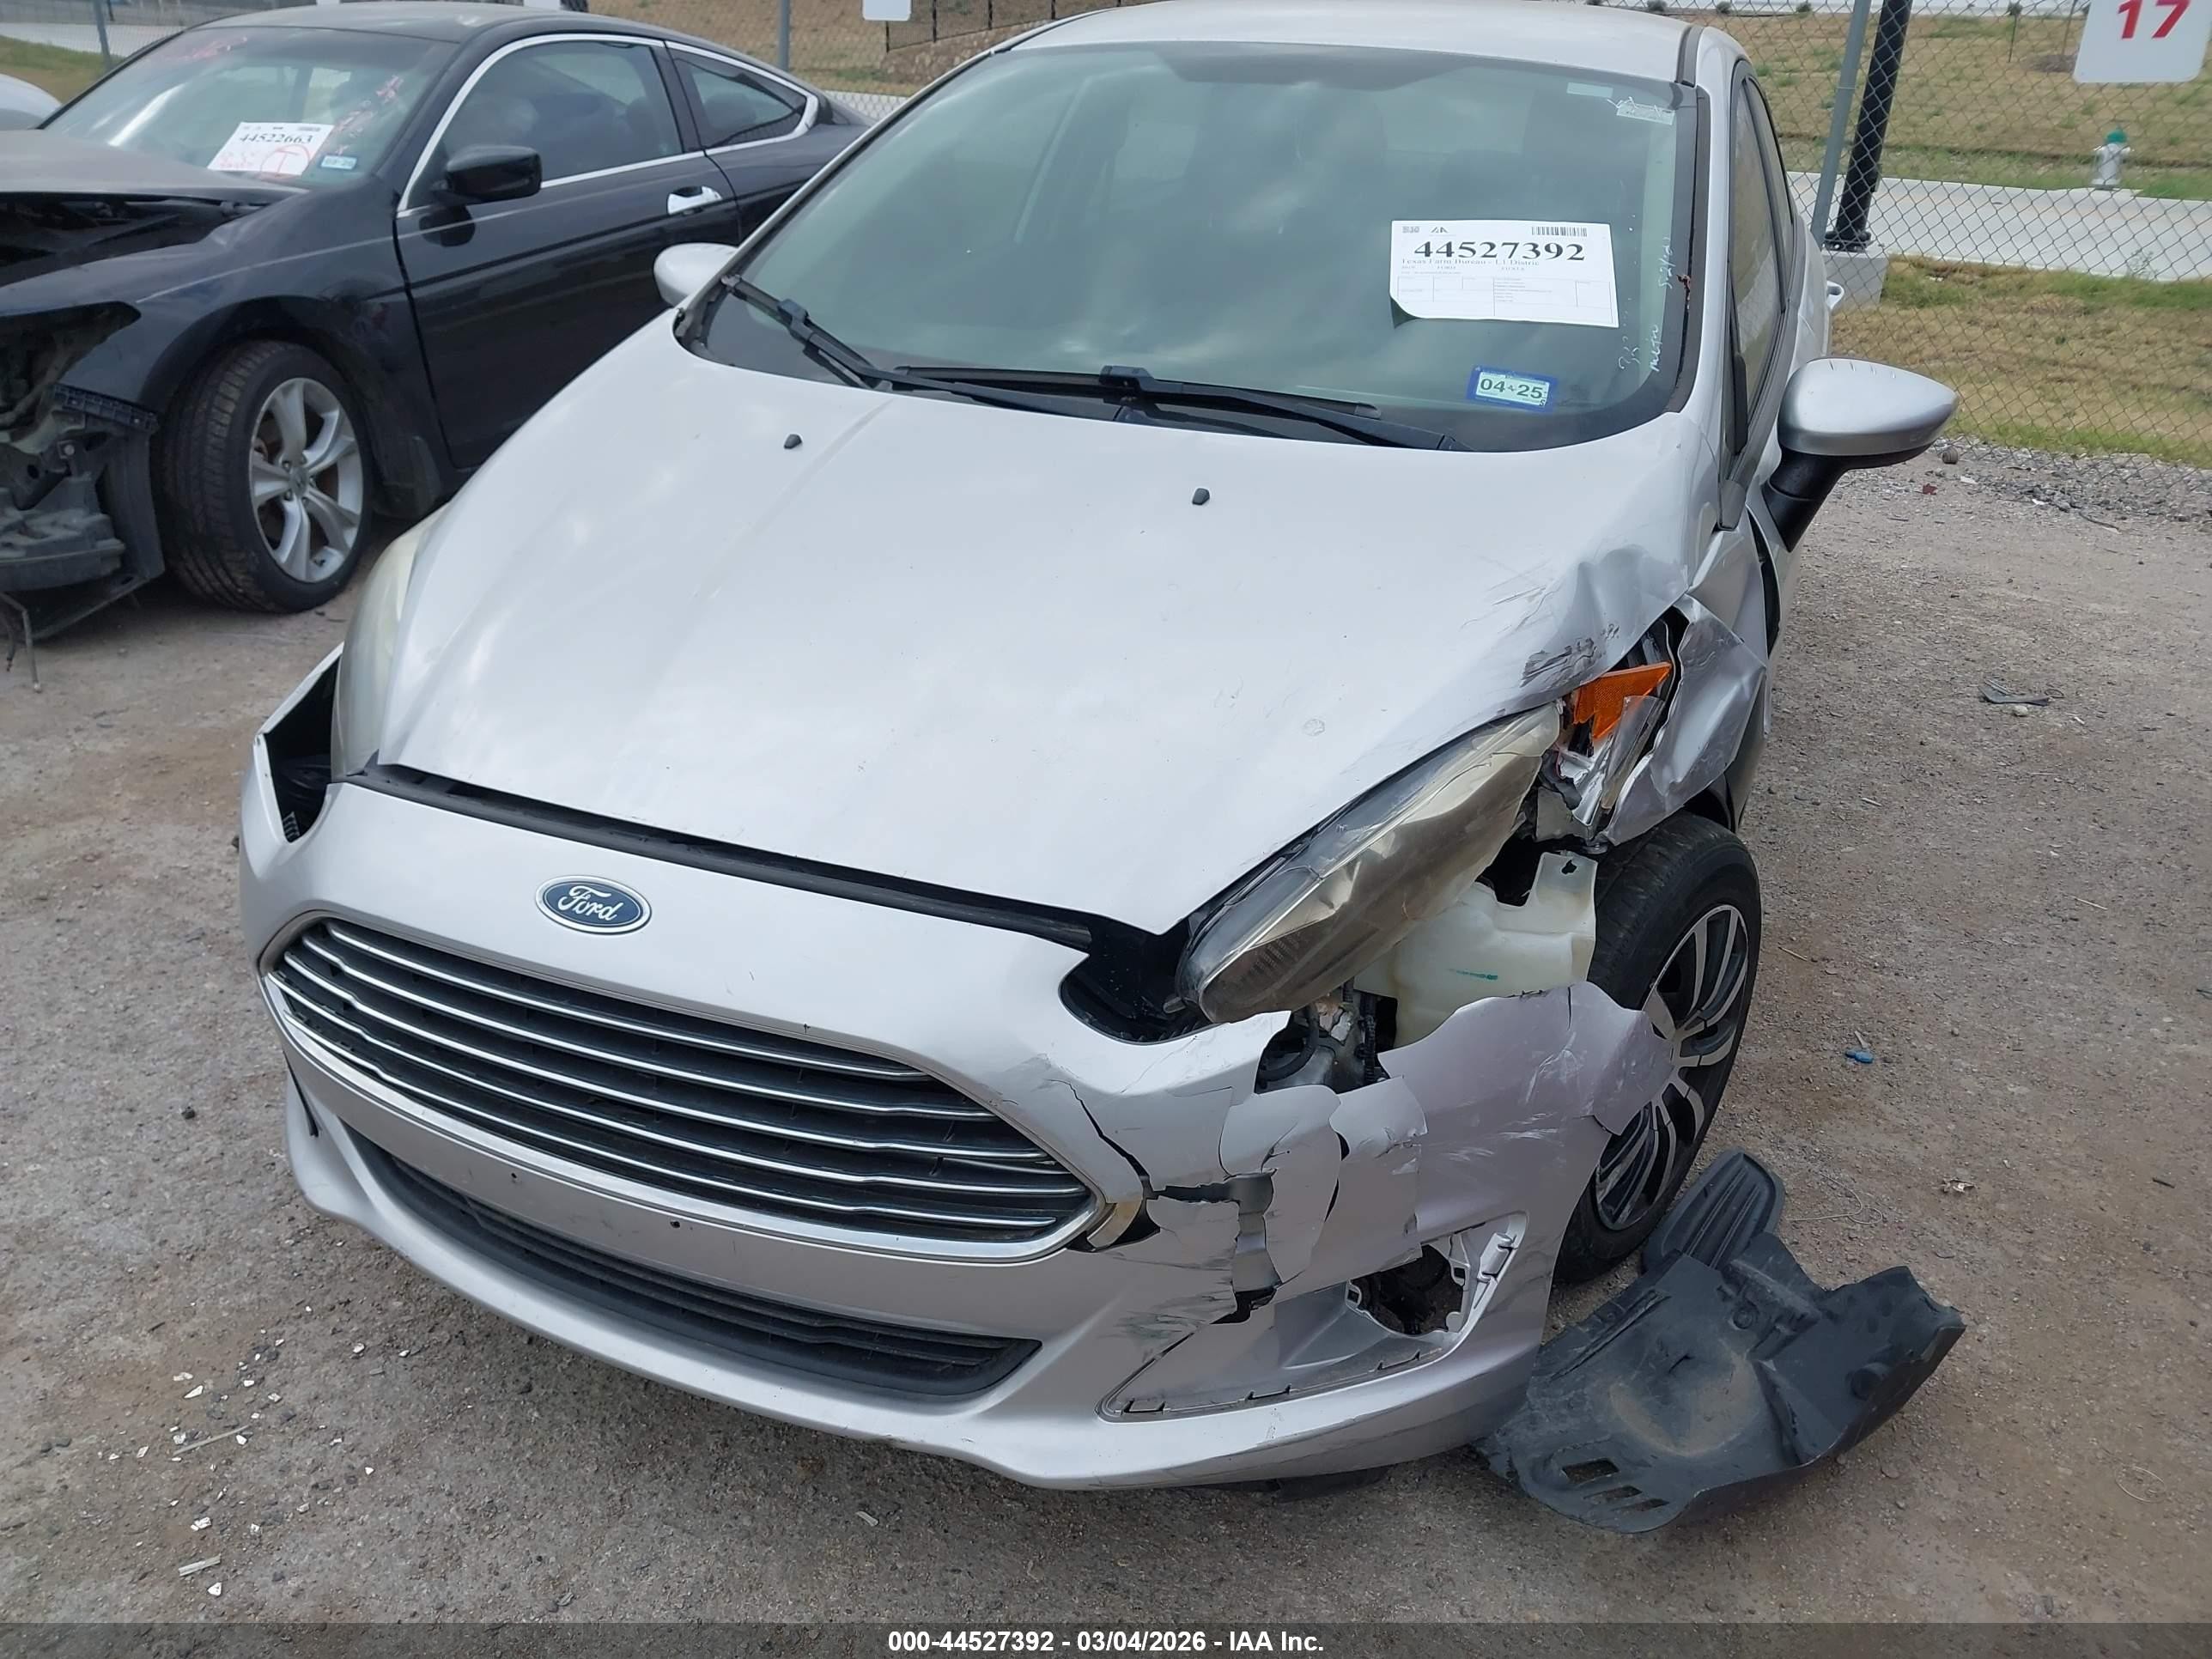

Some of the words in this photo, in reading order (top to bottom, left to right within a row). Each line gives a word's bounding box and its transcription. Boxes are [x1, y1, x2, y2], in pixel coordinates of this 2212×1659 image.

[2118, 0, 2191, 40] 17
[240, 132, 313, 144] 44522663
[1414, 240, 1586, 261] 44527392
[1480, 378, 1506, 393] 04
[1516, 384, 1544, 399] 25
[557, 884, 624, 921] Ford
